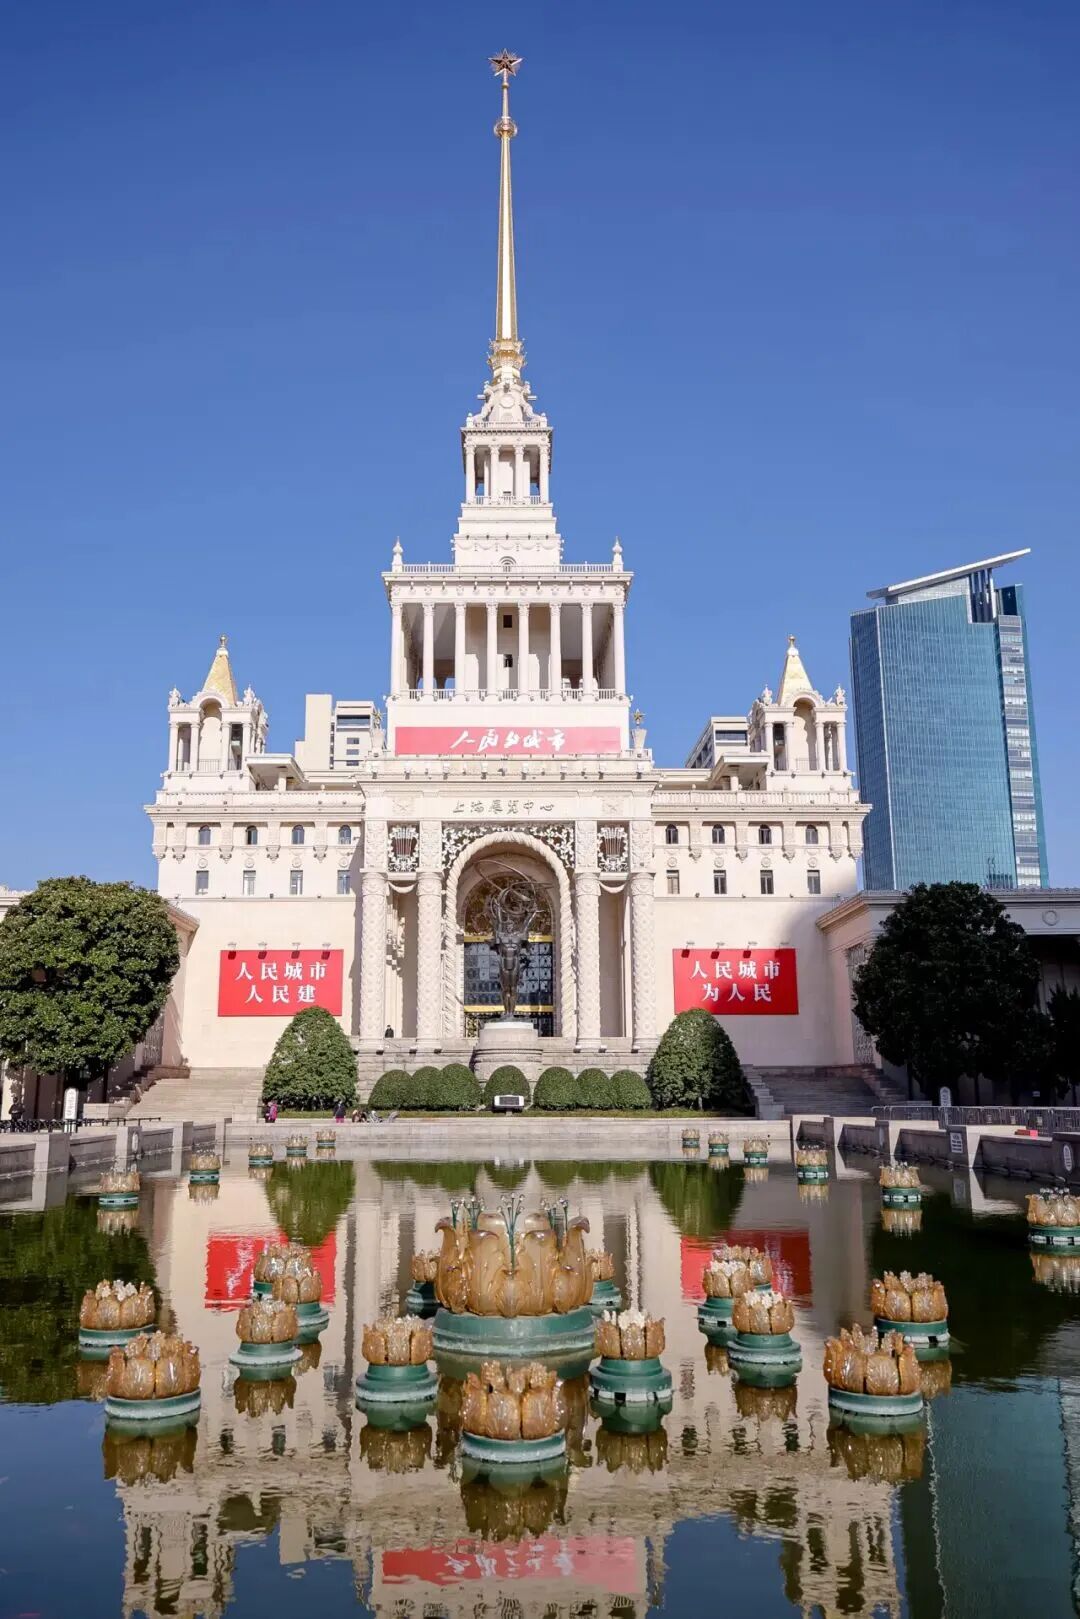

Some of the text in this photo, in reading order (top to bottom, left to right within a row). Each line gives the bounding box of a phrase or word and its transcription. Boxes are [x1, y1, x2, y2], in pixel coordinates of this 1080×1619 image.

[235, 961, 328, 981] 人民城市
[690, 960, 781, 979] 人民城市
[245, 984, 316, 1004] 人民建
[702, 983, 772, 1002] 为人民
